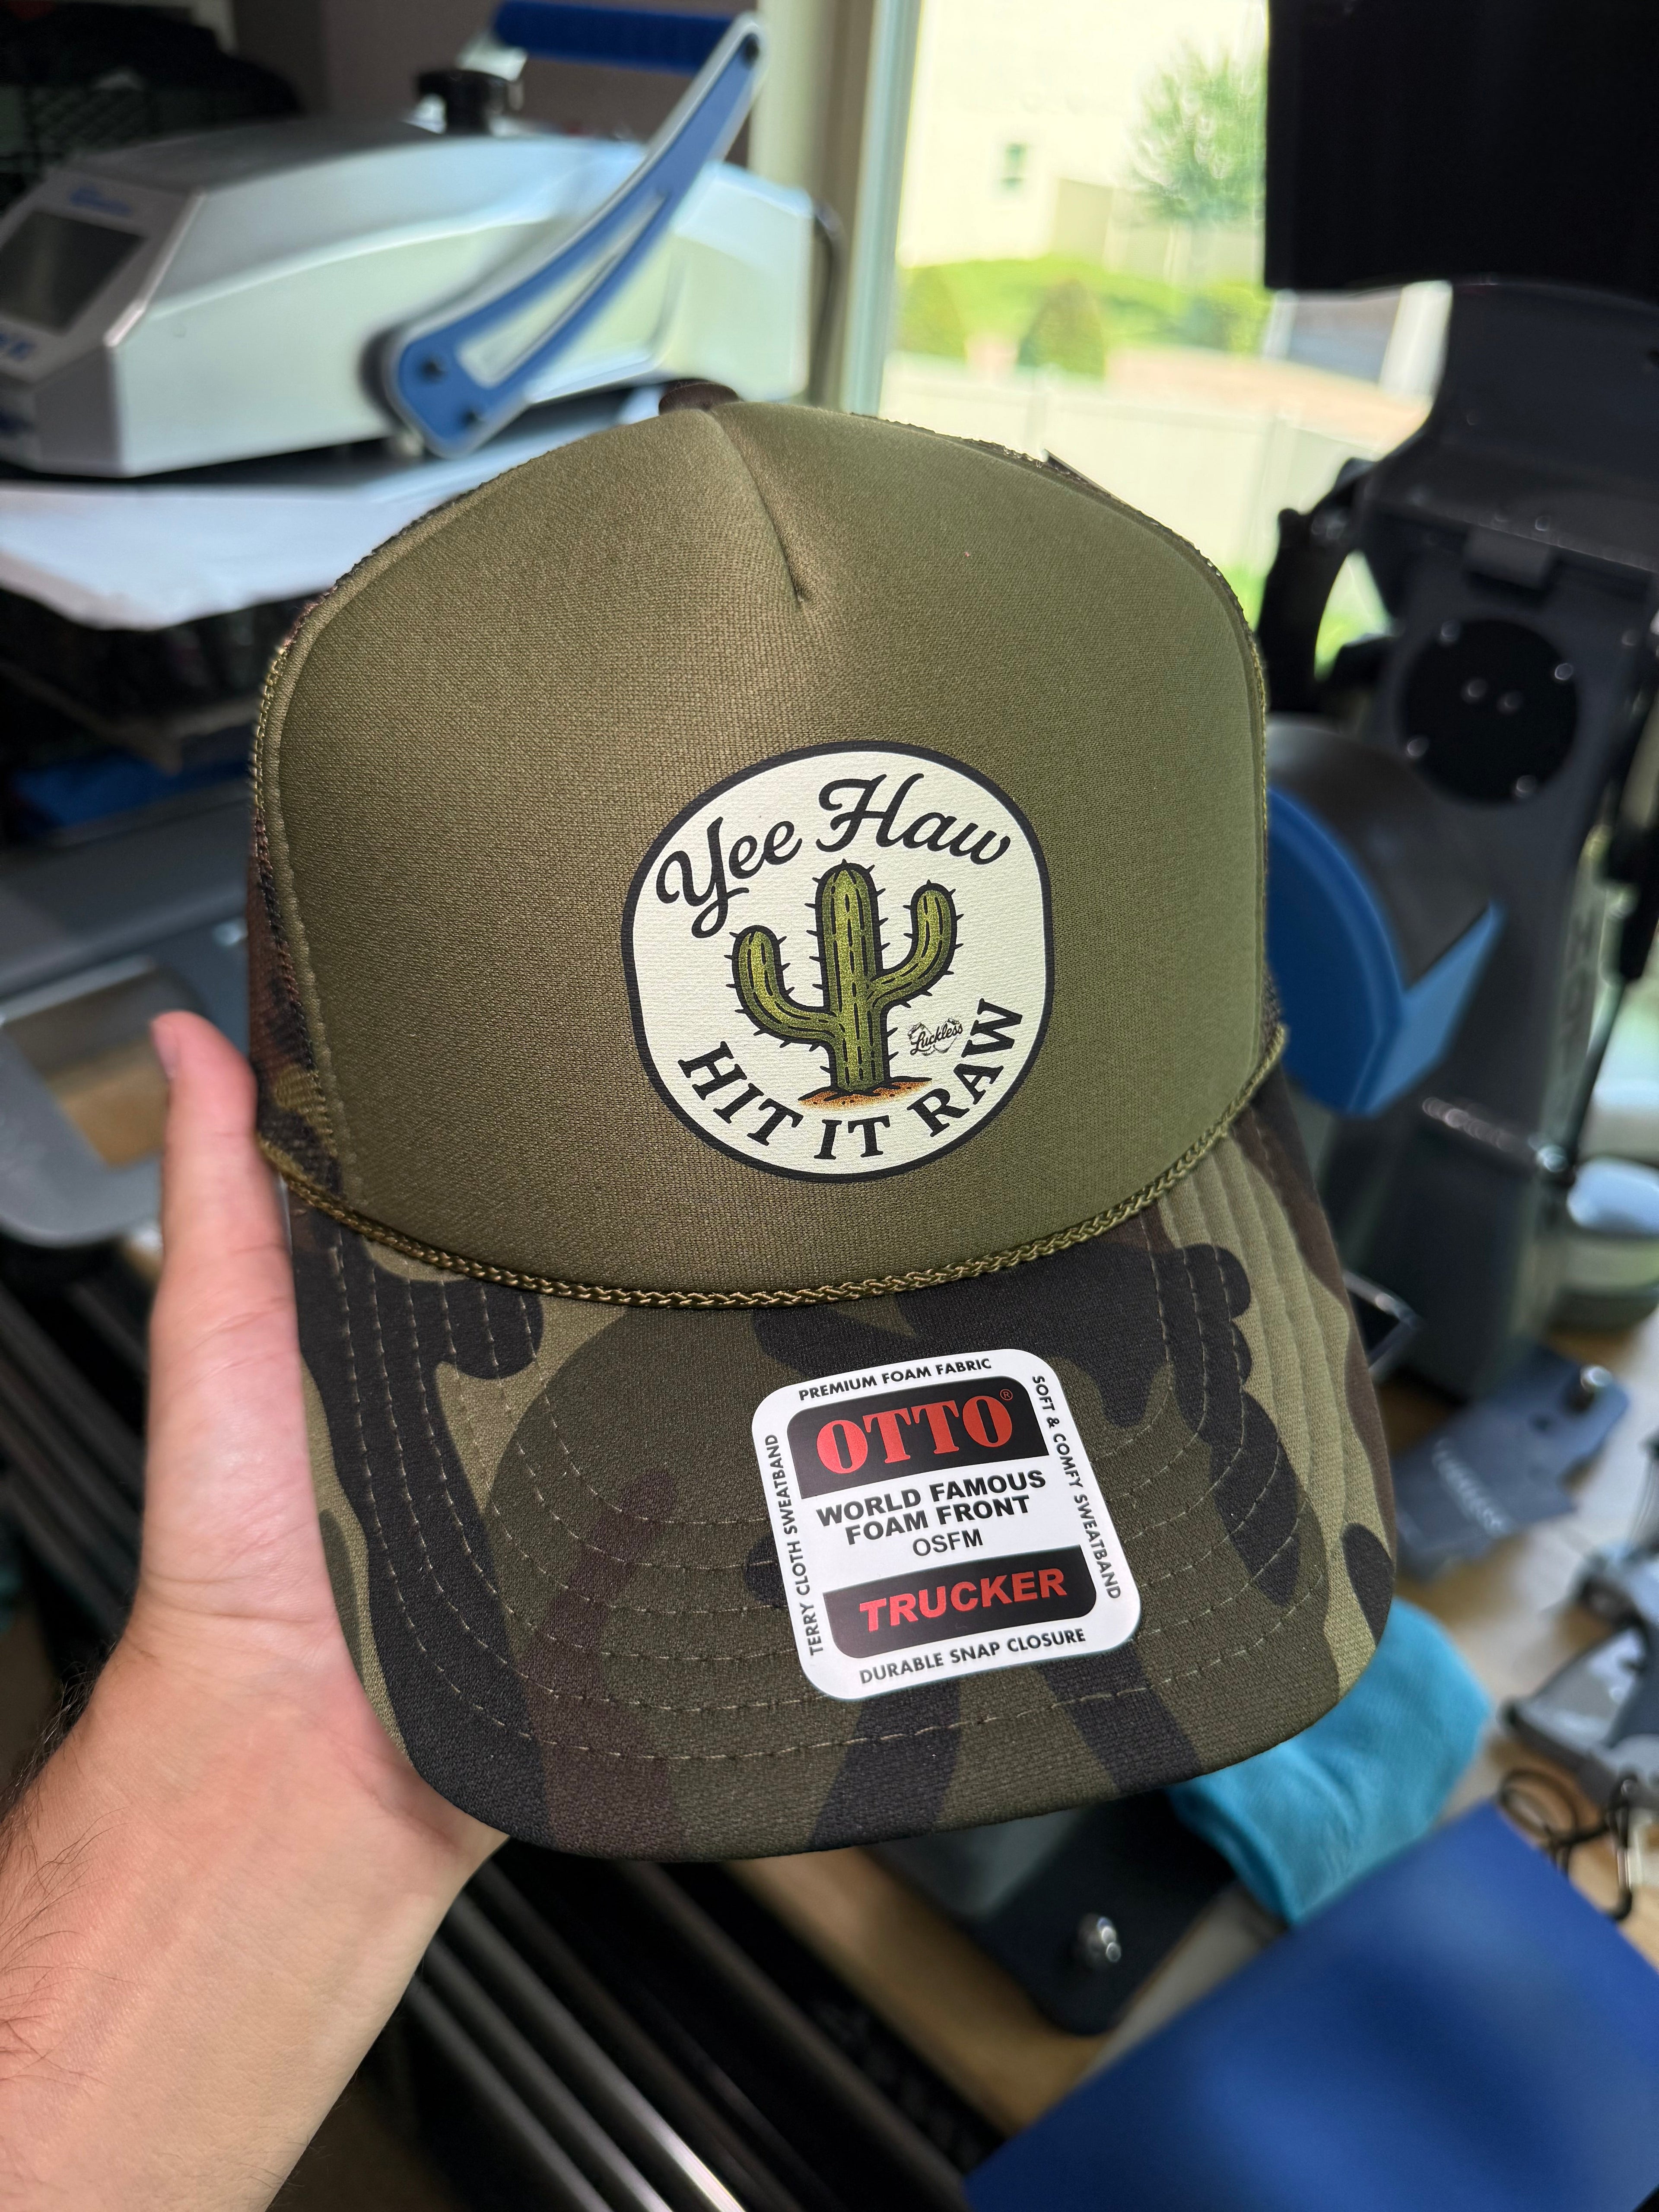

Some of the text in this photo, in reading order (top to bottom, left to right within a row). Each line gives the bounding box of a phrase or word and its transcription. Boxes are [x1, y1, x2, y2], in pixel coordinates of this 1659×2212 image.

[656, 773, 1011, 939] Yee Haw
[678, 998, 1023, 1160] HIT IT RAW
[798, 1358, 992, 1401] PREMIUM FOAM FABRIC
[817, 1471, 1046, 1526] WORLD FAMOUS
[1033, 1376, 1120, 1599] SOFT & COMFY SWEATBAND
[766, 1435, 823, 1656] TERRY CLOTH SWEATBAND
[846, 1495, 1030, 1545] FOAM FRONT
[912, 1529, 983, 1557] OSFM
[859, 1568, 1067, 1631] TRUCKER
[859, 1629, 1086, 1684] DURABLE SNAP CLOSURE
